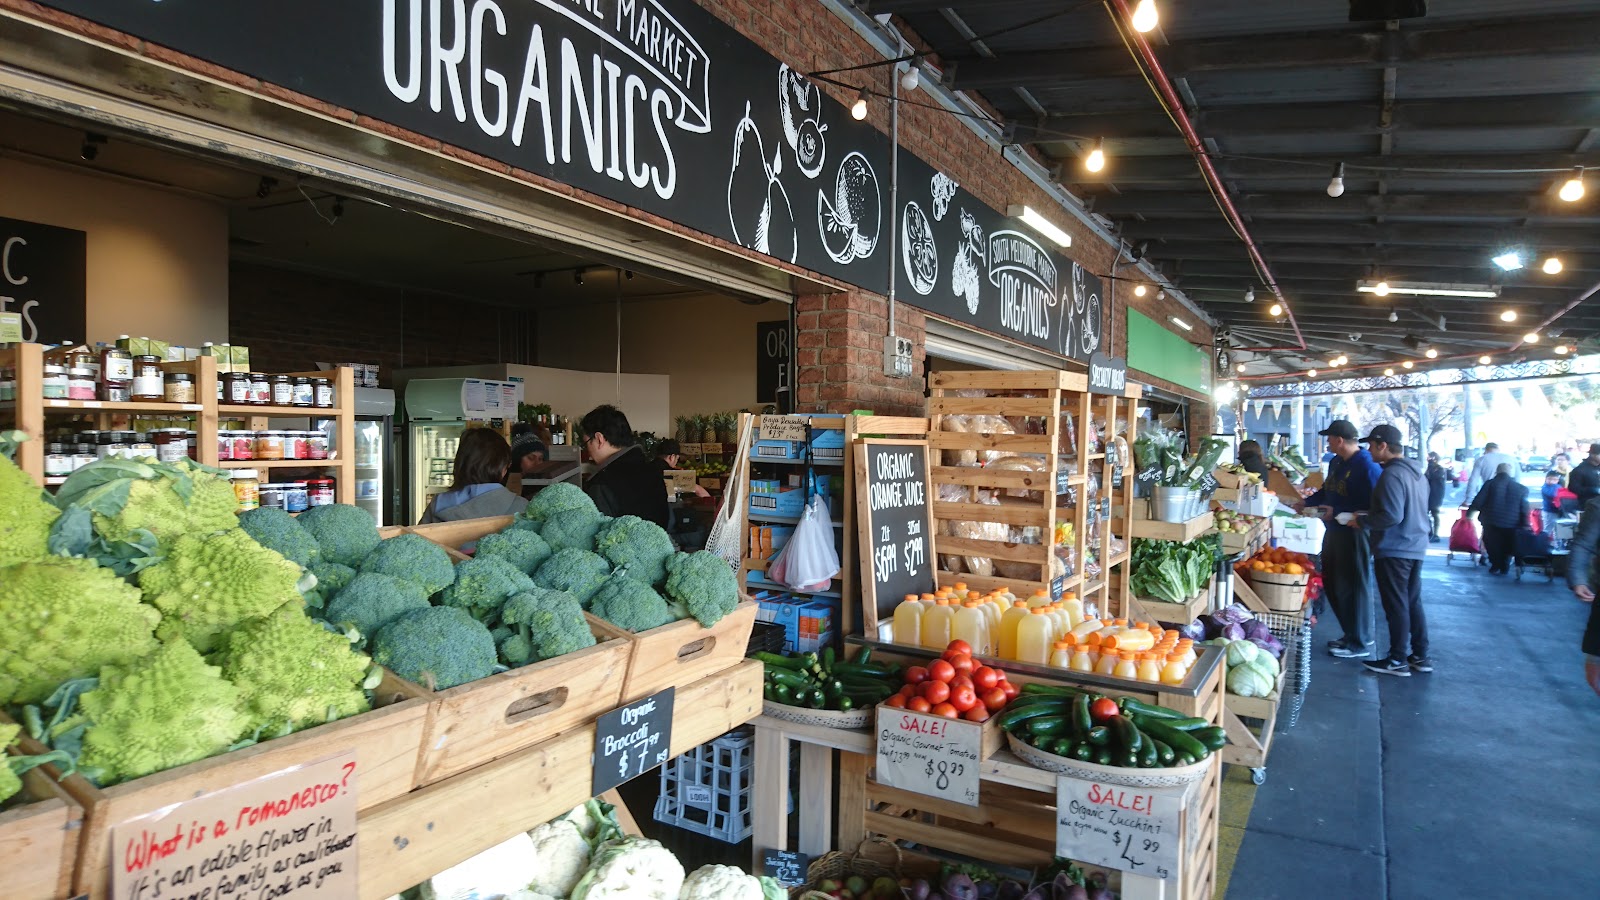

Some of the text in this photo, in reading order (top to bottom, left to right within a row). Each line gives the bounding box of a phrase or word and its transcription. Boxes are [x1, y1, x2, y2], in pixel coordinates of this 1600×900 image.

[616, 0, 697, 89] MARKET
[383, 0, 677, 200] ORGANICS
[993, 238, 1054, 288] SOUTH MELBOURNE MARKET
[1001, 272, 1049, 340] ORGANICS
[876, 452, 915, 481] ORGANIC
[870, 481, 925, 511] ORANGE JUICE
[621, 697, 656, 725] Organic
[899, 715, 947, 738] SALE!
[604, 721, 649, 757] Broccoli
[881, 729, 977, 761] Organic Gourmet Tomatoes
[125, 761, 356, 873] What is a romanesco?
[1069, 800, 1164, 834] Organic Zucchini
[1088, 784, 1153, 815] SALE!
[129, 815, 332, 900] It's an edible flower in
[215, 861, 267, 900] family
[273, 857, 292, 874] as
[297, 871, 314, 888] as
[315, 862, 343, 889] you
